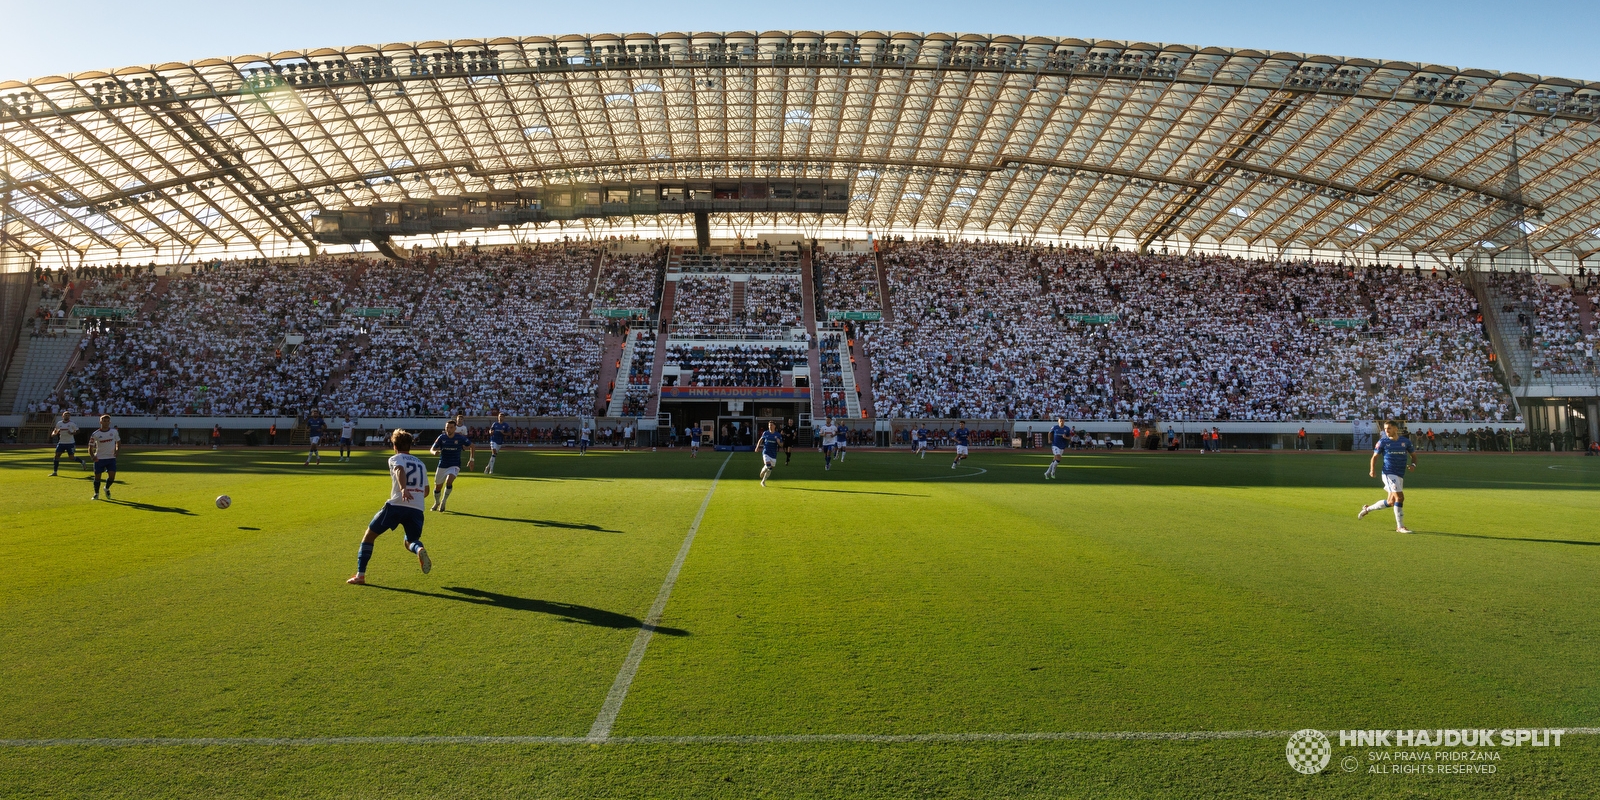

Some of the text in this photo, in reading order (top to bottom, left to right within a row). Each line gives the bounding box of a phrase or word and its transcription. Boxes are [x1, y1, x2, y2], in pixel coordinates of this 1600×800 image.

[689, 388, 783, 396] HNK HAJDUK SPLIT
[406, 462, 424, 487] 21
